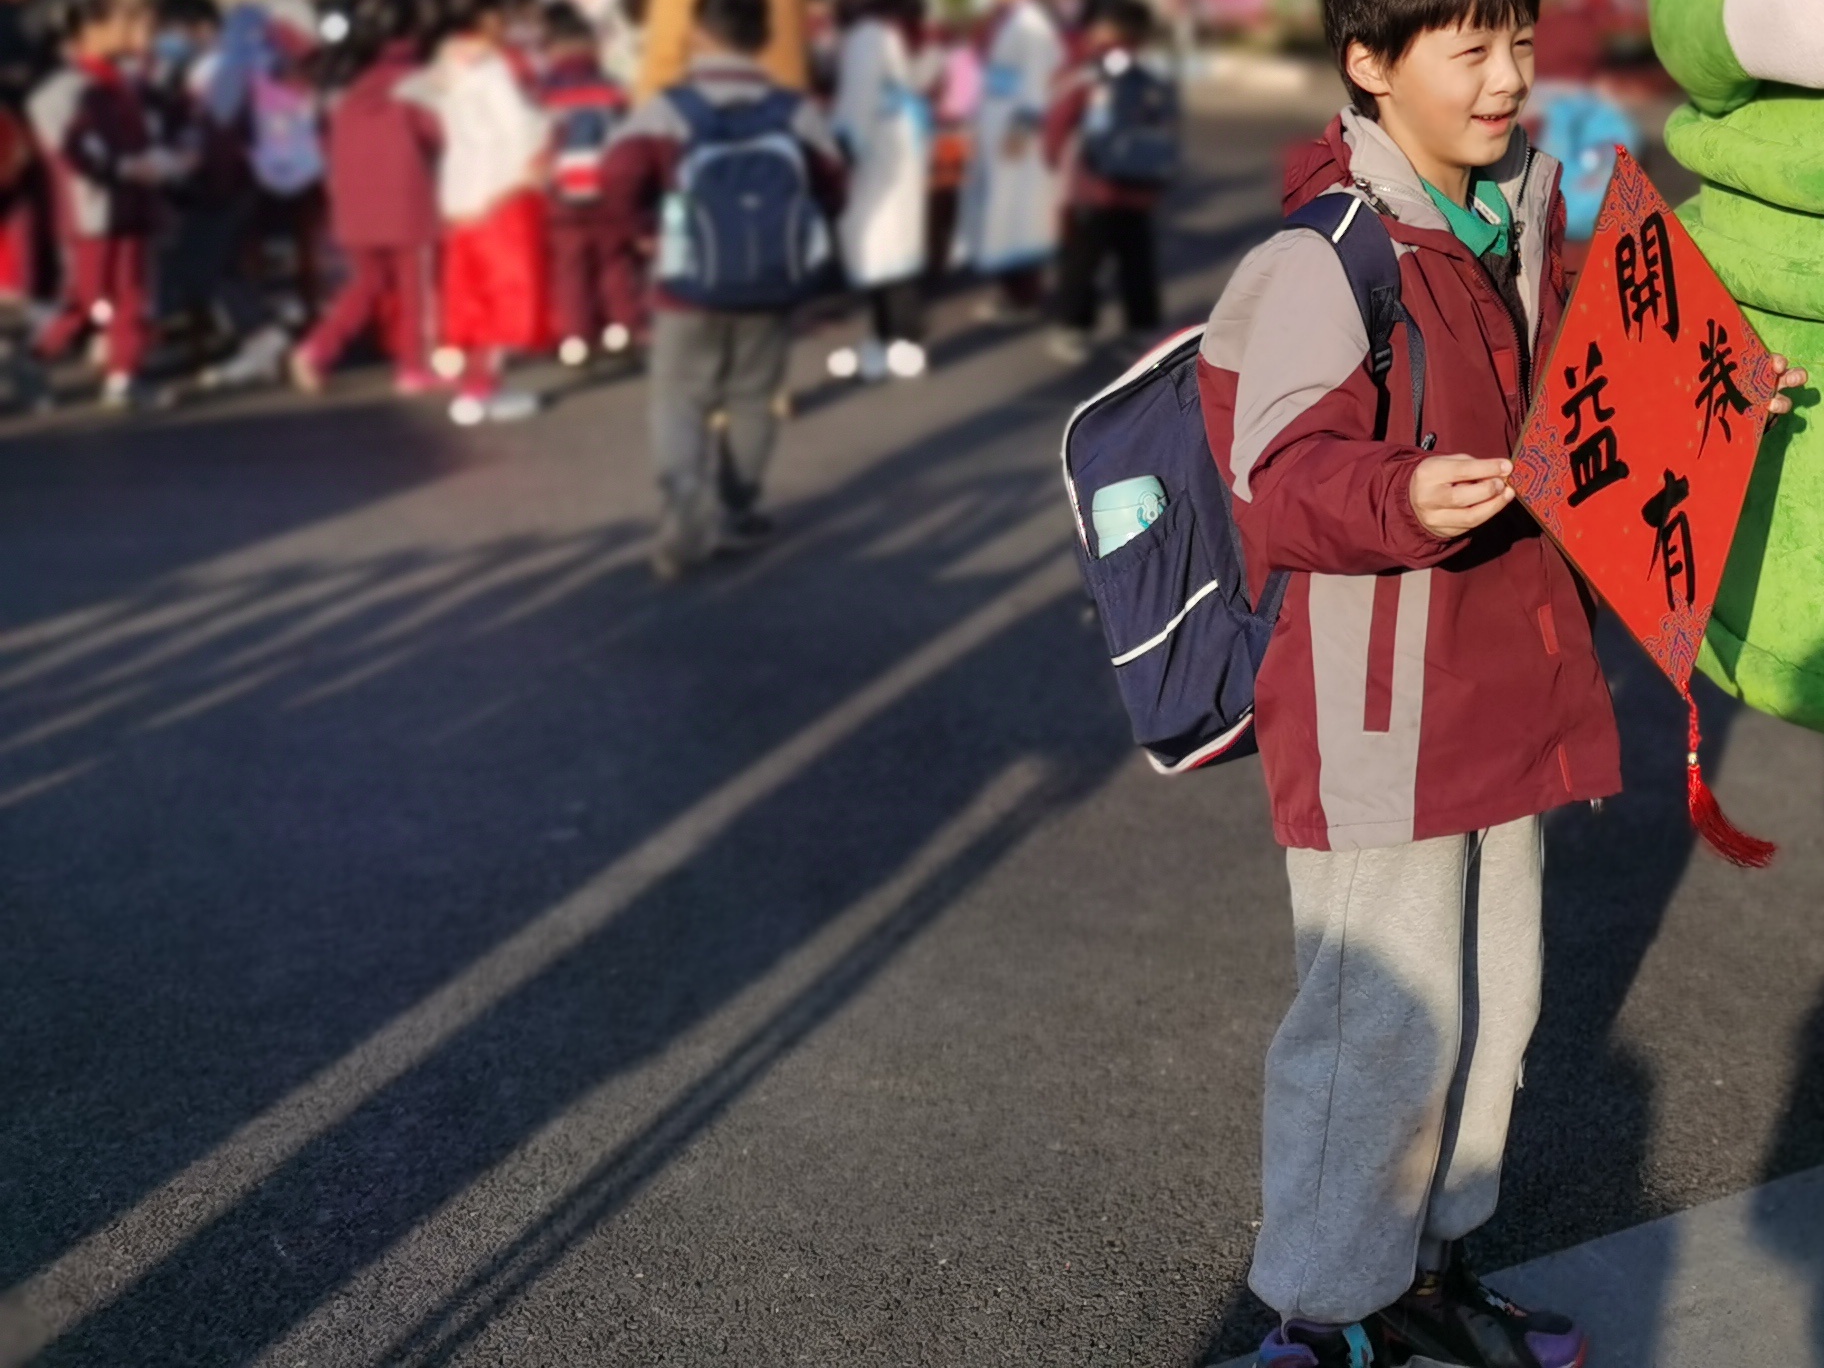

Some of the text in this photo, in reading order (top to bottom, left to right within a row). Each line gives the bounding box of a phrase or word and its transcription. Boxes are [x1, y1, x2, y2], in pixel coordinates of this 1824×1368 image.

[1614, 209, 1680, 343] 開
[1561, 341, 1630, 508] 益
[1640, 468, 1696, 611] 有
